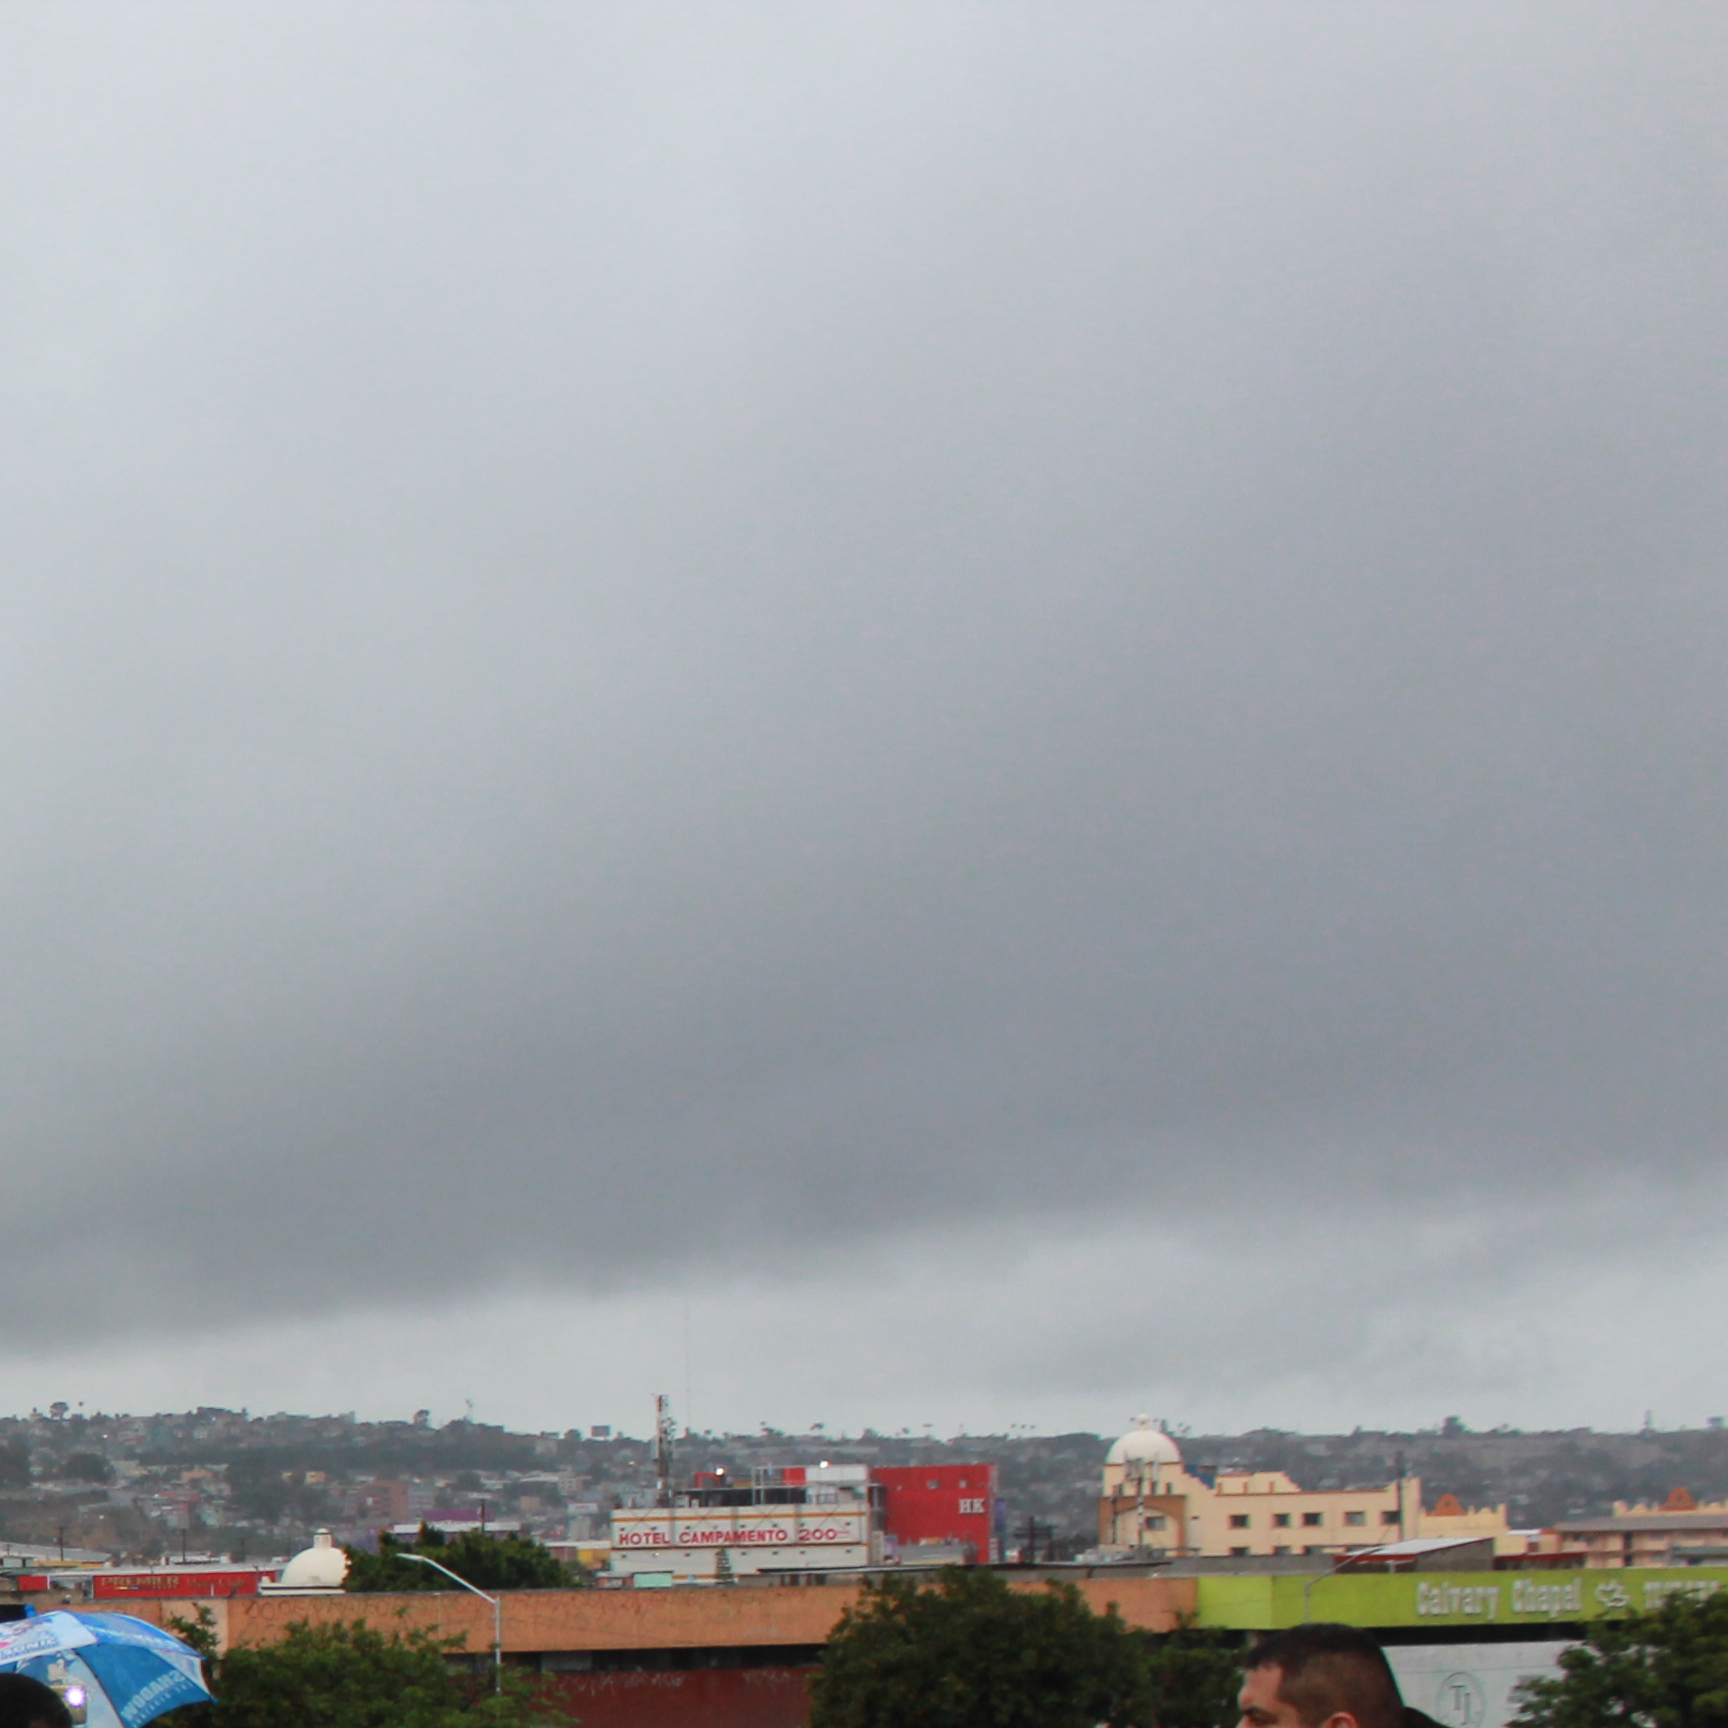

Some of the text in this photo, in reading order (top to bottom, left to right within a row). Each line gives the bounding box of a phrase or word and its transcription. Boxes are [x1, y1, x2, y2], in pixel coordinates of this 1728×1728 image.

[959, 1498, 985, 1514] HK
[619, 1533, 670, 1545] HOTEL
[679, 1529, 788, 1544] CAMPAMENTO
[1417, 1577, 1583, 1620] Calvary Chapel
